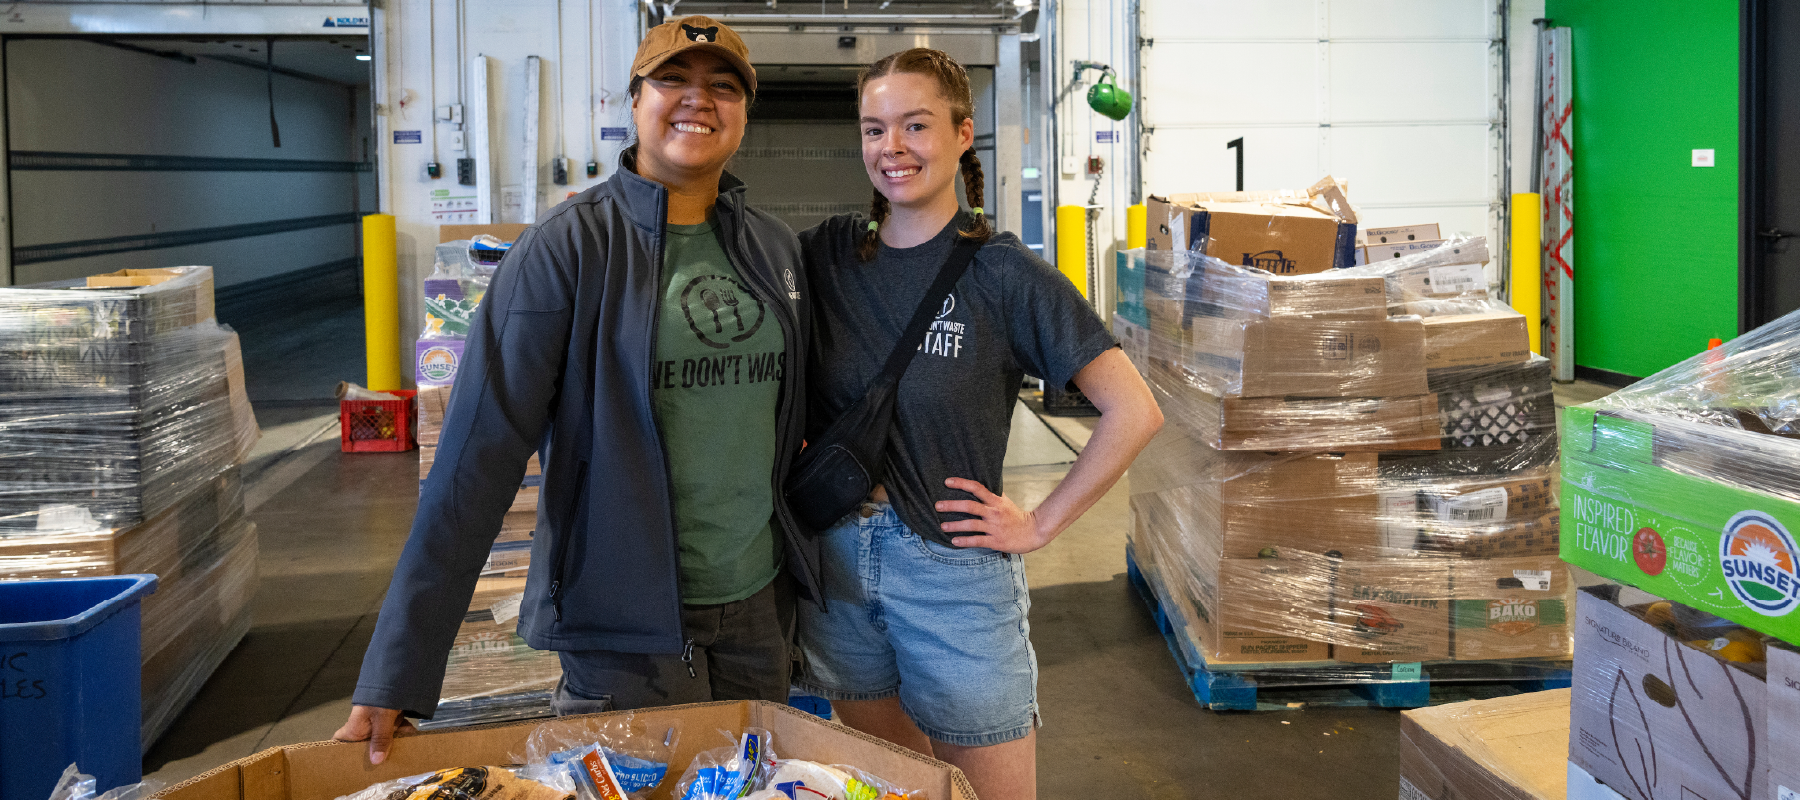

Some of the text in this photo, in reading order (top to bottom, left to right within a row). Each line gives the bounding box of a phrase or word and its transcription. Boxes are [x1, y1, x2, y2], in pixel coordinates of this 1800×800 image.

[1227, 137, 1244, 191] 1
[943, 321, 965, 334] WASTE
[917, 331, 963, 358] TAFF
[420, 363, 457, 373] SUNSET
[681, 354, 743, 389] DON'T
[1573, 493, 1634, 535] INSPIRED
[1576, 522, 1628, 564] FLAVOR
[1673, 535, 1699, 554] BECAUSE
[1669, 546, 1705, 568] FLAVOR
[1672, 560, 1700, 579] MATTERS
[1722, 559, 1800, 599] SUNSET
[1490, 604, 1536, 620] BAKO
[1584, 615, 1621, 642] SIGNATURE
[1622, 637, 1650, 658] BRAND
[589, 760, 606, 784] Carbs
